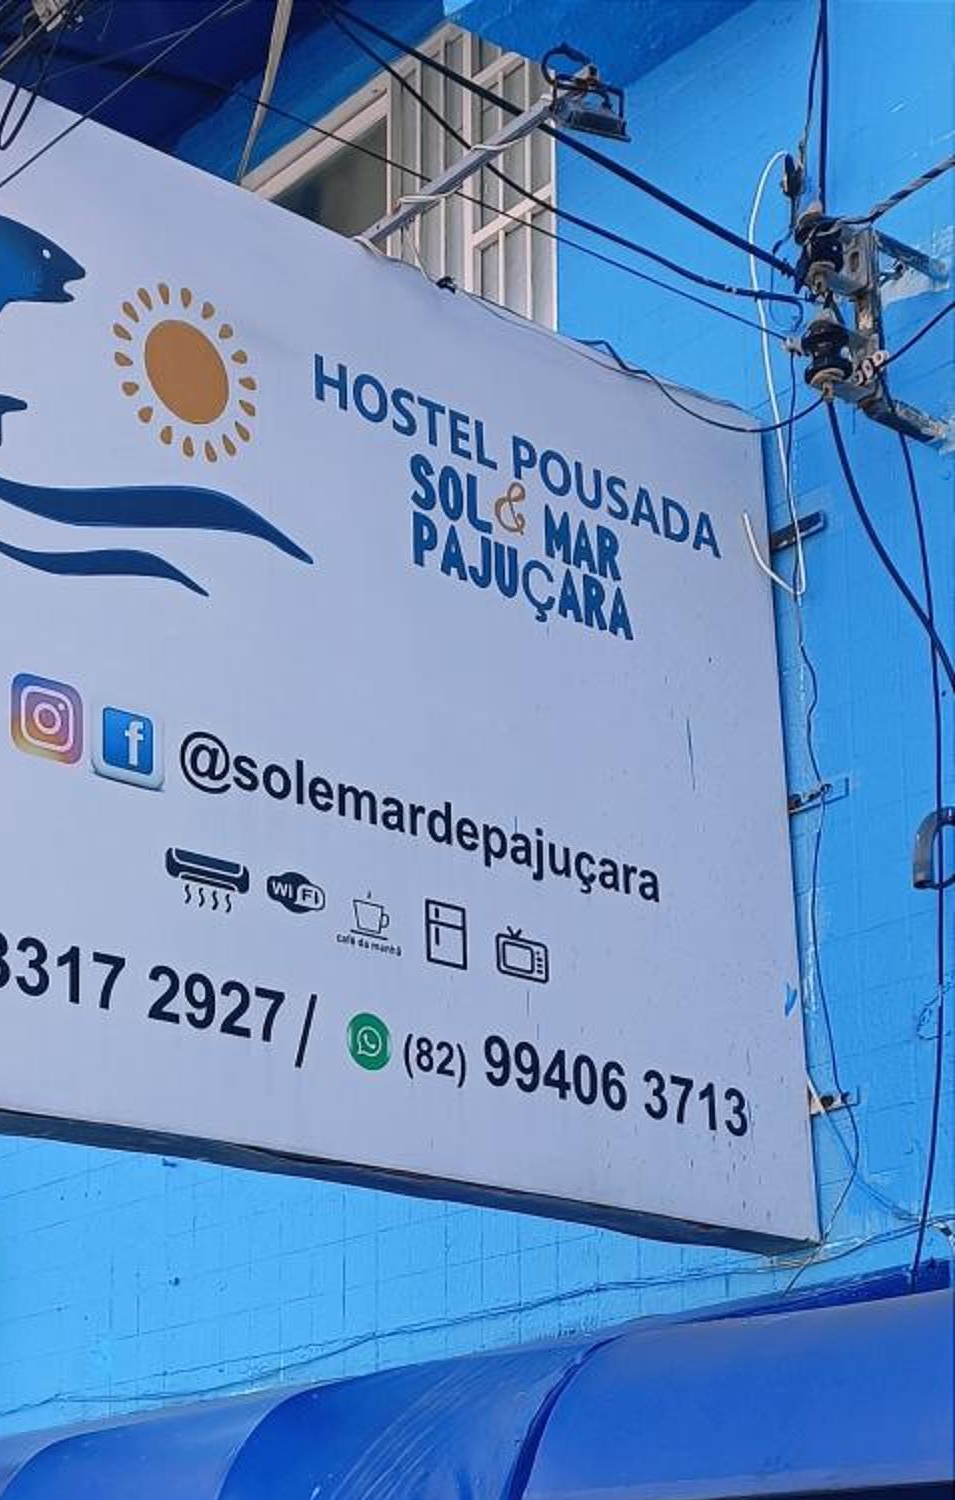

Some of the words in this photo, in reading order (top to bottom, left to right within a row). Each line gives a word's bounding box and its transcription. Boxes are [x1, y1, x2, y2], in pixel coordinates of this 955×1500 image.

[314, 353, 498, 470] HOSTEL
[512, 435, 722, 559] POUSADA
[410, 453, 494, 534] SOL
[494, 481, 527, 535] &
[545, 504, 622, 580] MAR
[412, 511, 634, 641] PAJUÇARA
[179, 731, 660, 902] @solemardepajuçara
[403, 1033, 466, 1088] (82)
[484, 1035, 627, 1111] 99406
[642, 1069, 748, 1137] 3713
